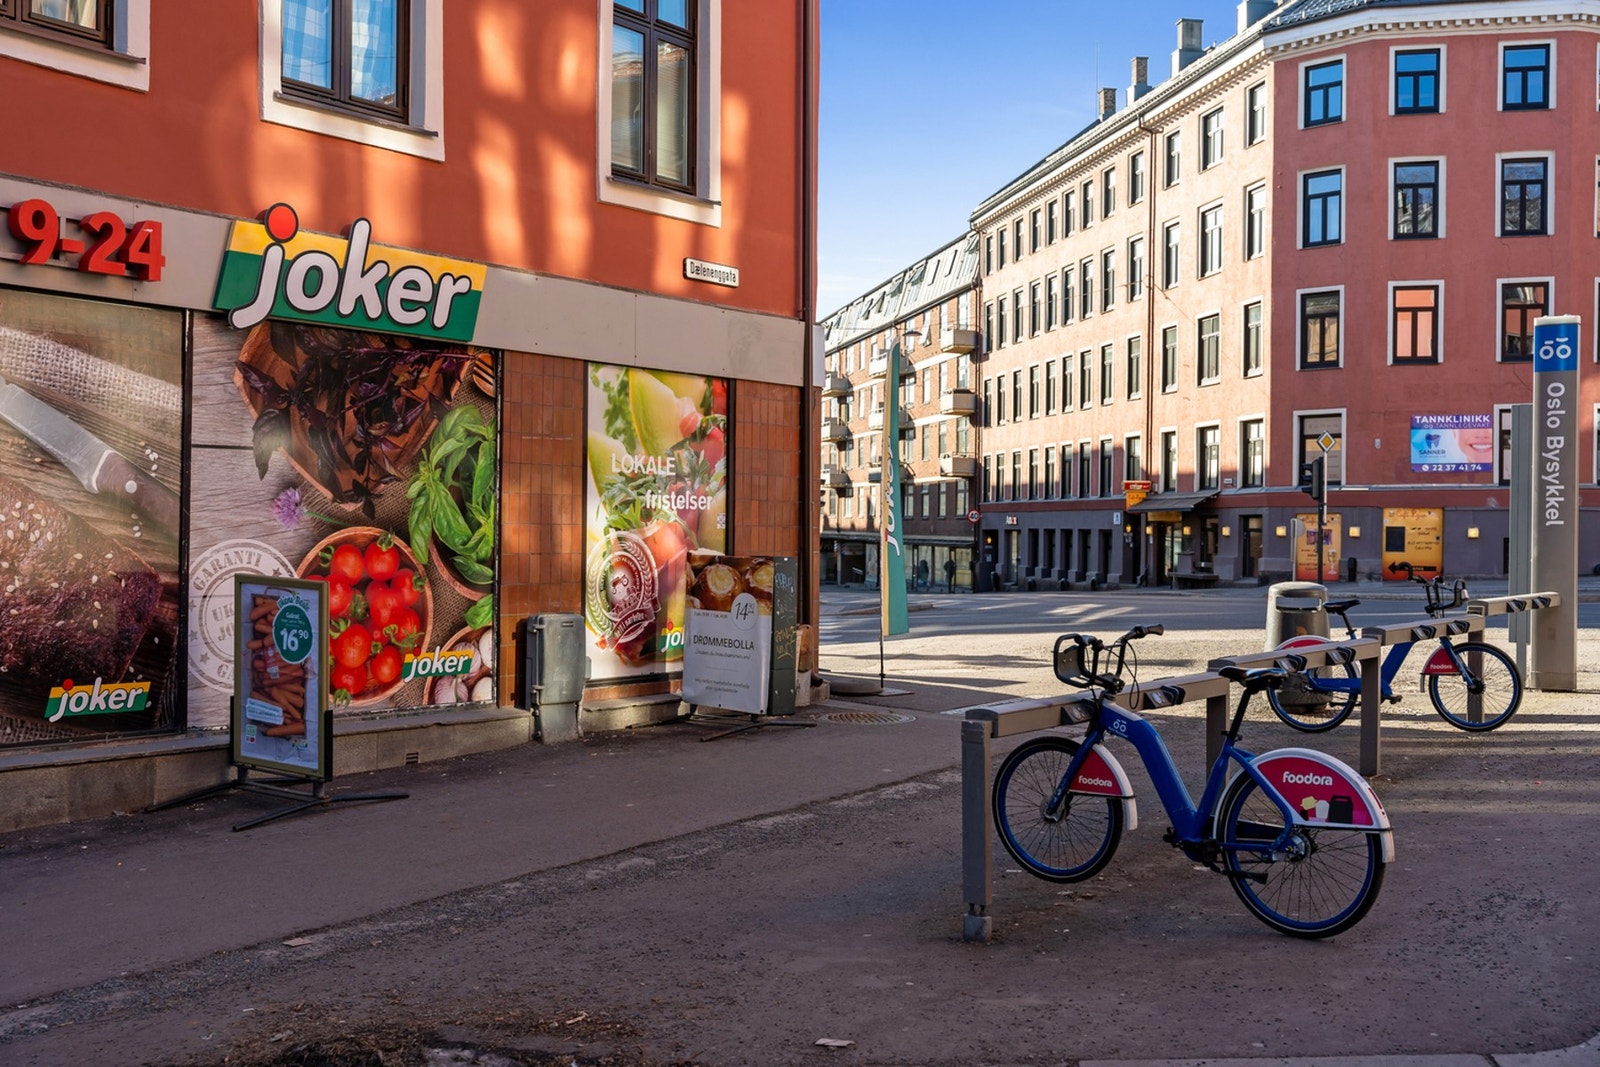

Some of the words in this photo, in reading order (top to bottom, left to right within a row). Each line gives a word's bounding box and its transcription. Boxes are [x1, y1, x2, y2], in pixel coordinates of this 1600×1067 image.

[8, 198, 166, 282] 9-24
[228, 202, 472, 329] joker
[1415, 415, 1490, 423] TANNKLINIKK
[1547, 382, 1566, 429] Oslo
[611, 453, 676, 476] LOKALE
[1541, 436, 1565, 526] Bysykkel
[644, 489, 713, 510] fristelser
[193, 550, 262, 591] GARANTI
[693, 634, 754, 651] DRØMMEBOLLA
[404, 645, 469, 682] joker
[49, 677, 144, 722] joker
[1078, 775, 1112, 788] foodora
[1282, 771, 1333, 786] foodora
